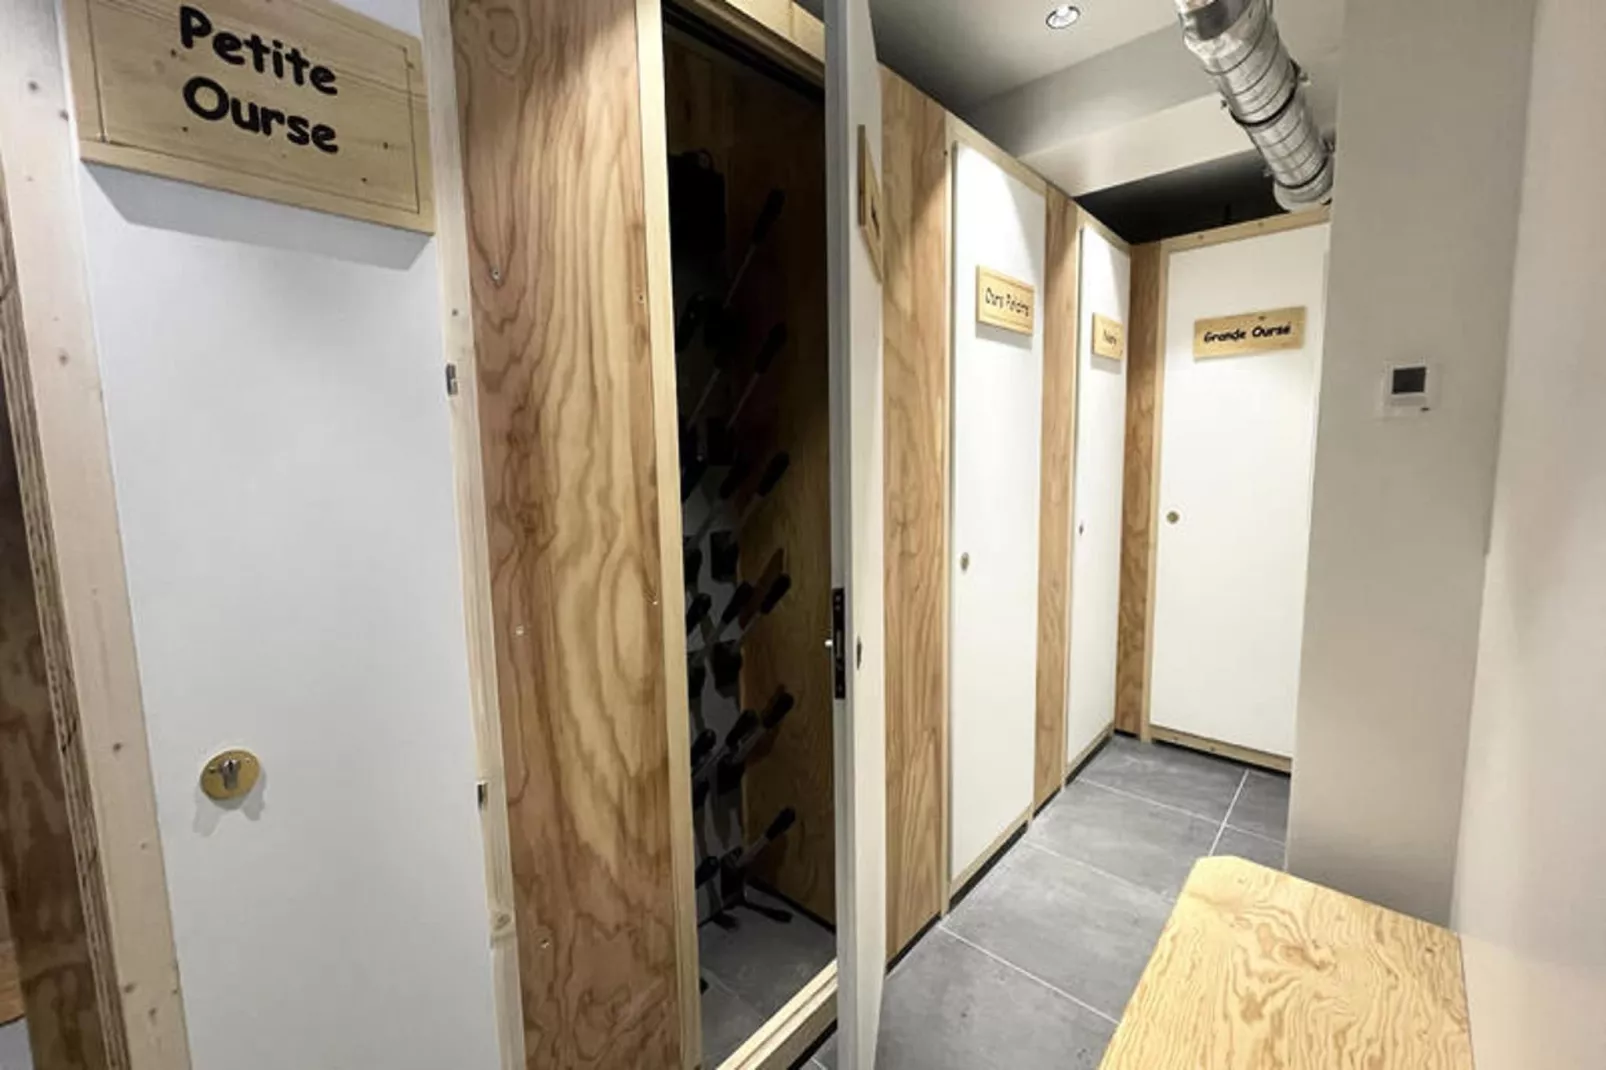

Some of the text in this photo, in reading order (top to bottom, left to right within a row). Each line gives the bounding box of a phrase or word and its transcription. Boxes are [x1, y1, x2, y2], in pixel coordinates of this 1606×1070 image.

[180, 6, 338, 95] Petite
[183, 76, 338, 153] Ourse
[1203, 324, 1291, 343] Grande Ourse
